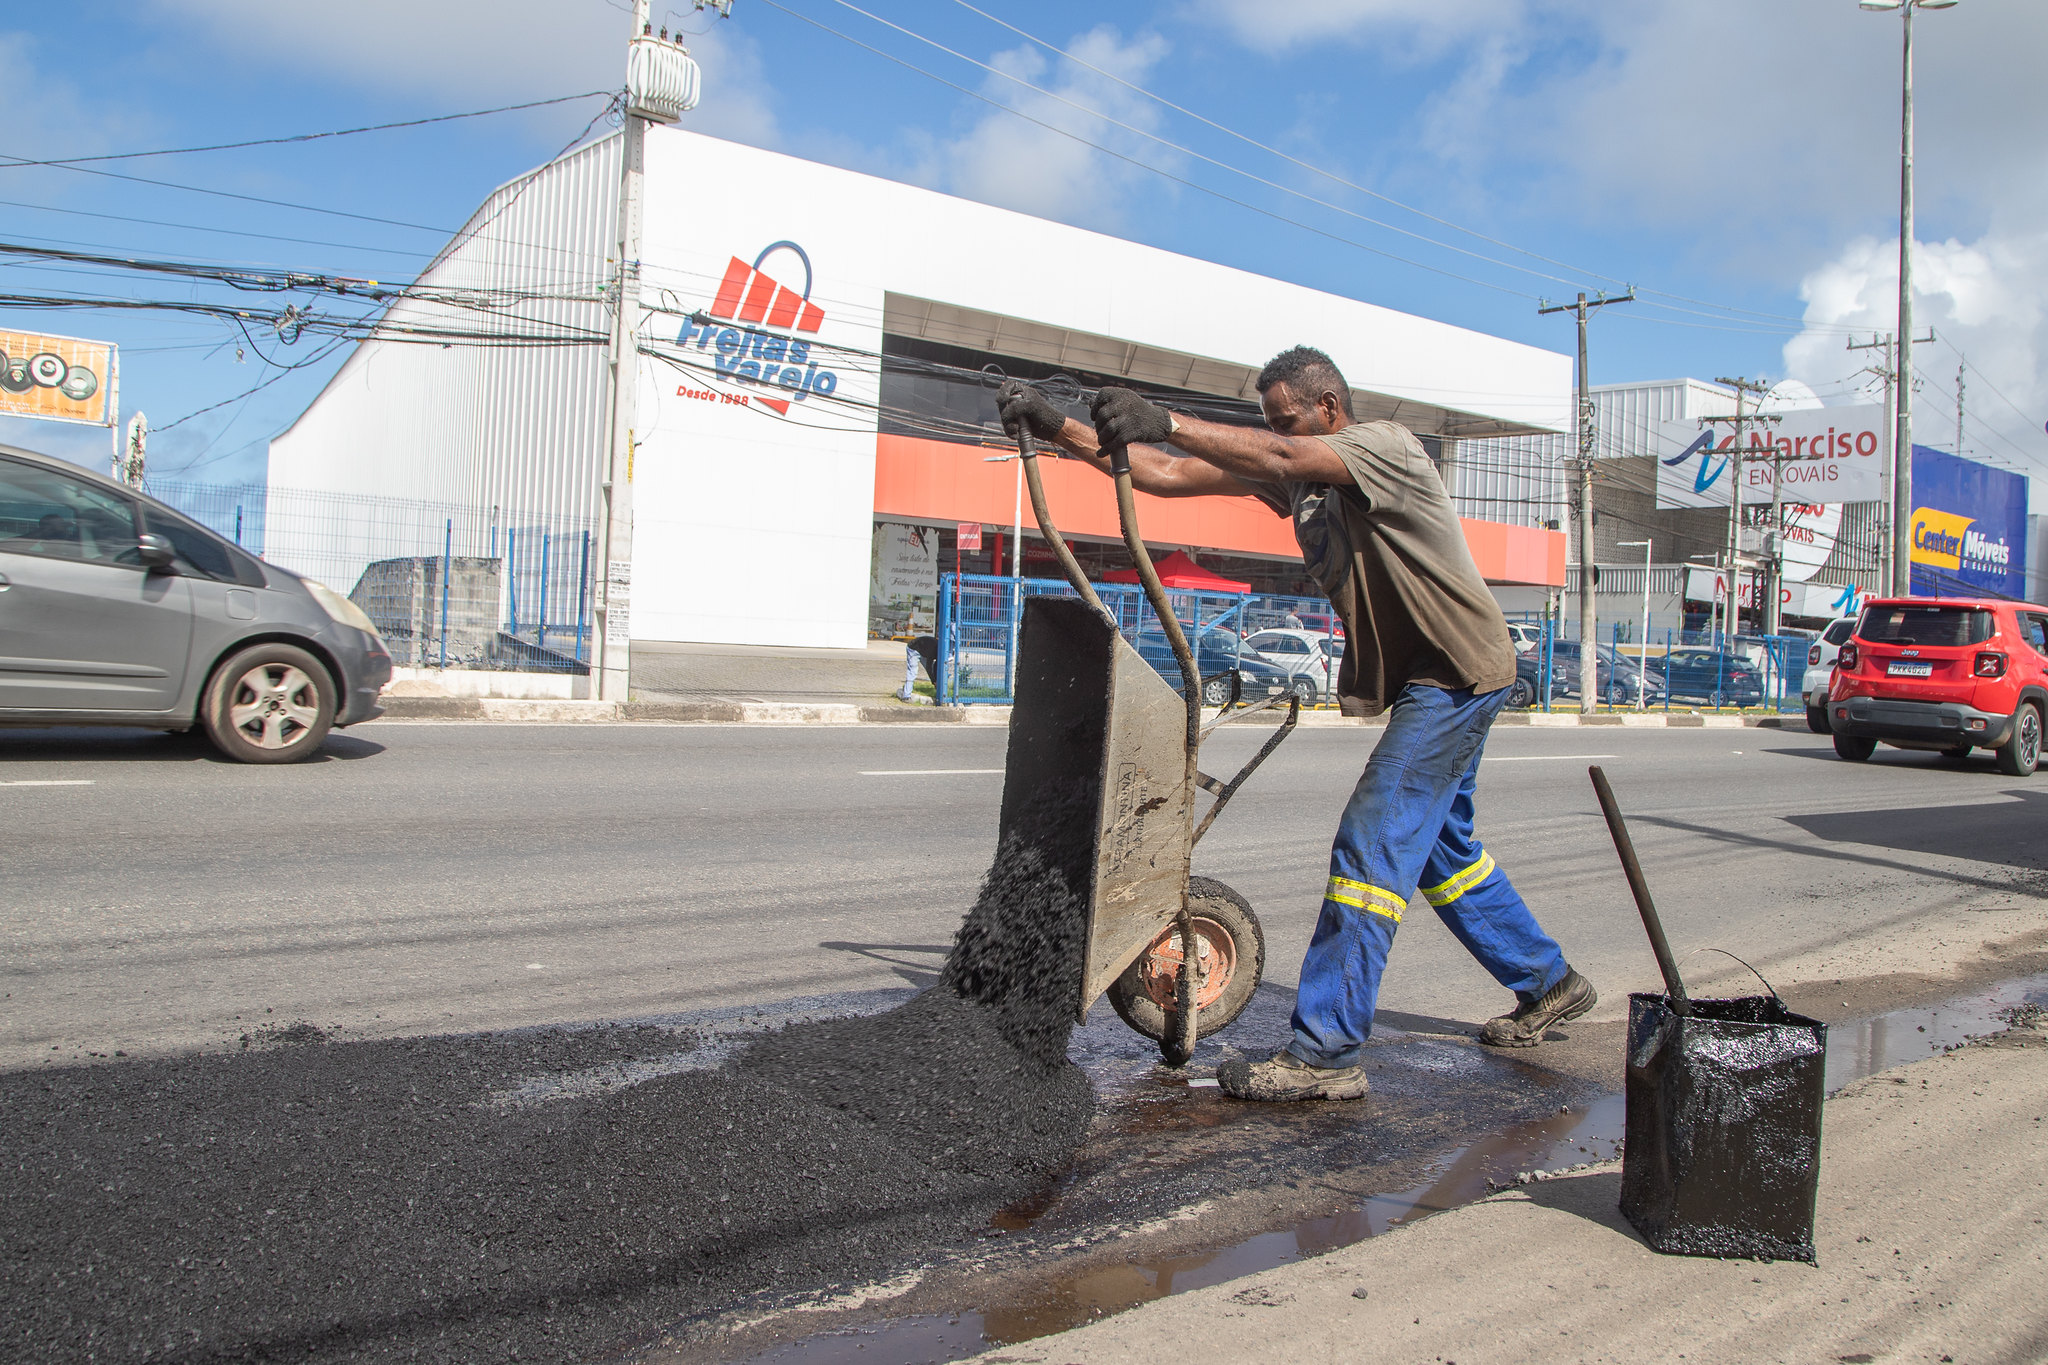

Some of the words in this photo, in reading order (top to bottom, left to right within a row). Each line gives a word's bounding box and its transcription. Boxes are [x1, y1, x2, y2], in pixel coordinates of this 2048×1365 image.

[675, 315, 812, 363] Freitas
[676, 385, 716, 402] Desde
[720, 391, 749, 406] 1988
[1750, 427, 1878, 463] Narciso
[1915, 521, 1960, 556] Center
[1963, 530, 2010, 565] Móveis
